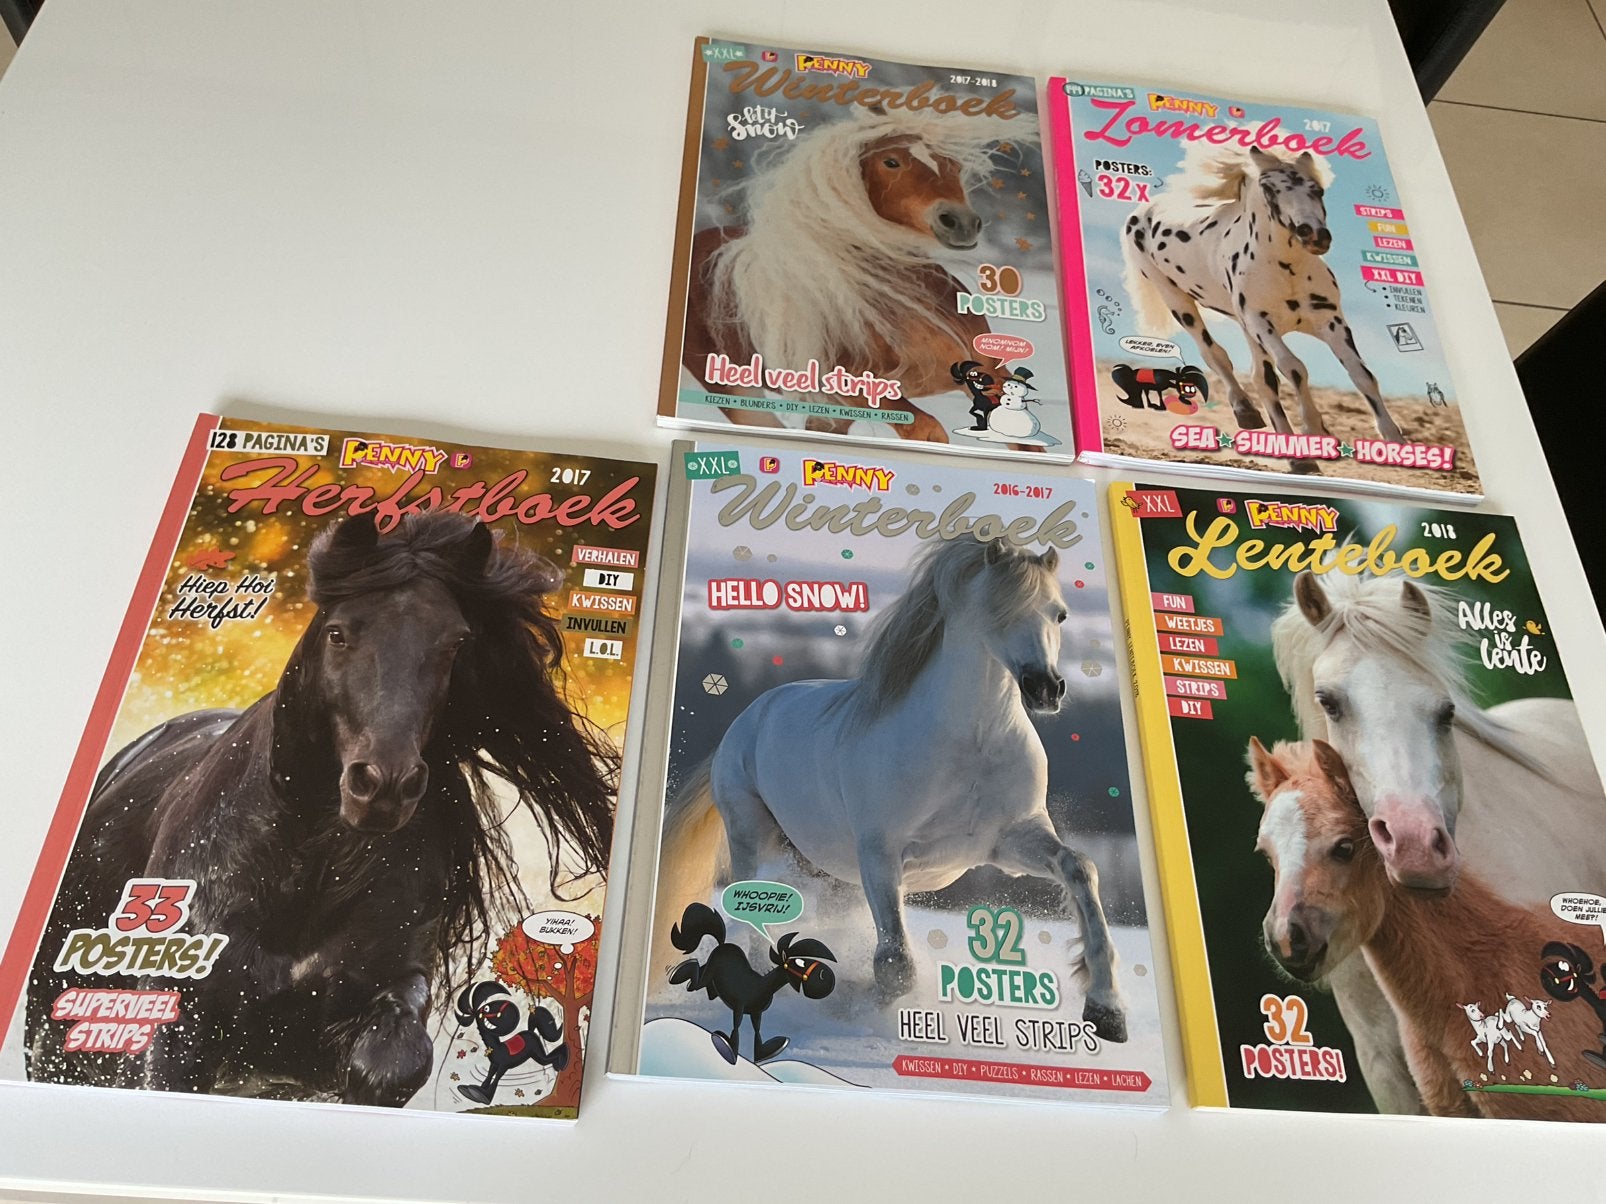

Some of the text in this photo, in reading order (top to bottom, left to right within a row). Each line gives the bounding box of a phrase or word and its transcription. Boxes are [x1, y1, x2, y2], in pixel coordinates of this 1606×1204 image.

[713, 47, 736, 60] XXL
[796, 54, 871, 78] PENNY
[722, 60, 1020, 120] Winterboek
[950, 75, 997, 87] 2017-2018
[1084, 86, 1134, 98] PAGINA'S
[1148, 93, 1218, 117] PENNY
[1084, 98, 1371, 160] Zomerboek
[1304, 119, 1331, 132] 2017
[1095, 159, 1152, 176] POSTERS:
[1097, 174, 1132, 201] 32
[1360, 207, 1393, 218] STRIPS
[1377, 223, 1396, 234] FUN
[1378, 238, 1406, 249] LEZEN
[1366, 252, 1411, 265] KWISSEN
[978, 264, 1022, 296] 30
[1372, 269, 1418, 284] XXL DIY
[958, 294, 1044, 320] POSTERS
[1395, 304, 1426, 313] KLEUREN
[707, 354, 901, 408] Heel veel strips
[705, 395, 909, 422] KIEZEN BLUNDERS DIY LEZEN KWISSEN RASSEN
[211, 431, 325, 452] 128 PAGINA'S
[1170, 425, 1454, 469] SEA SUMMER HORSES!
[341, 439, 446, 473] PENNY
[698, 457, 729, 475] XXL
[803, 459, 894, 491] PENNY
[550, 467, 591, 486] 2017
[221, 456, 641, 534] Herfstboek
[992, 482, 1053, 500] 2016-2017
[710, 473, 1083, 548] Winterboek
[1145, 495, 1175, 513] XXL
[1245, 501, 1339, 533] PENNY
[1421, 521, 1456, 540] 2018
[1167, 510, 1510, 584] Lenteboek
[577, 549, 636, 566] VERHALEN
[178, 574, 276, 598] Hiep Hoi
[598, 573, 620, 587] DIY
[571, 594, 633, 612] KWISSEN
[711, 580, 865, 609] HELLO SNOW!
[1163, 594, 1187, 609] FUN
[168, 597, 267, 629] Herfst!
[1458, 601, 1517, 632] Alles
[566, 617, 627, 634] INVULLEN
[1164, 616, 1216, 633] WEETJES
[1169, 637, 1205, 654] LEZEN
[1494, 630, 1512, 648] is
[589, 642, 619, 657] L.O.L.
[1480, 636, 1547, 675] lente
[1173, 657, 1230, 676] KWISSEN
[1176, 680, 1220, 698] STRIPS
[1181, 700, 1202, 716] DIY
[733, 890, 793, 902] WHOOPIE!
[1562, 898, 1601, 906] WHOEHOE,
[116, 884, 190, 933] 33
[734, 902, 790, 914] IJSVRIJ!
[539, 926, 578, 936] BUKKEN!
[545, 918, 575, 926] YIHAA!
[967, 905, 1025, 964] 32
[59, 932, 224, 974] POSTERS!
[940, 964, 1056, 1006] POSTERS
[55, 991, 178, 1019] SUPERVEEL
[1262, 996, 1312, 1044] 32
[67, 1022, 150, 1049] STRIPS
[899, 1009, 1099, 1052] HEEL VEEL STRIPS
[1243, 1047, 1344, 1081] POSTERS!
[902, 1060, 1142, 1088] KWISSEN DIY PUZZELS RASSEN LEZEN LACHEN
